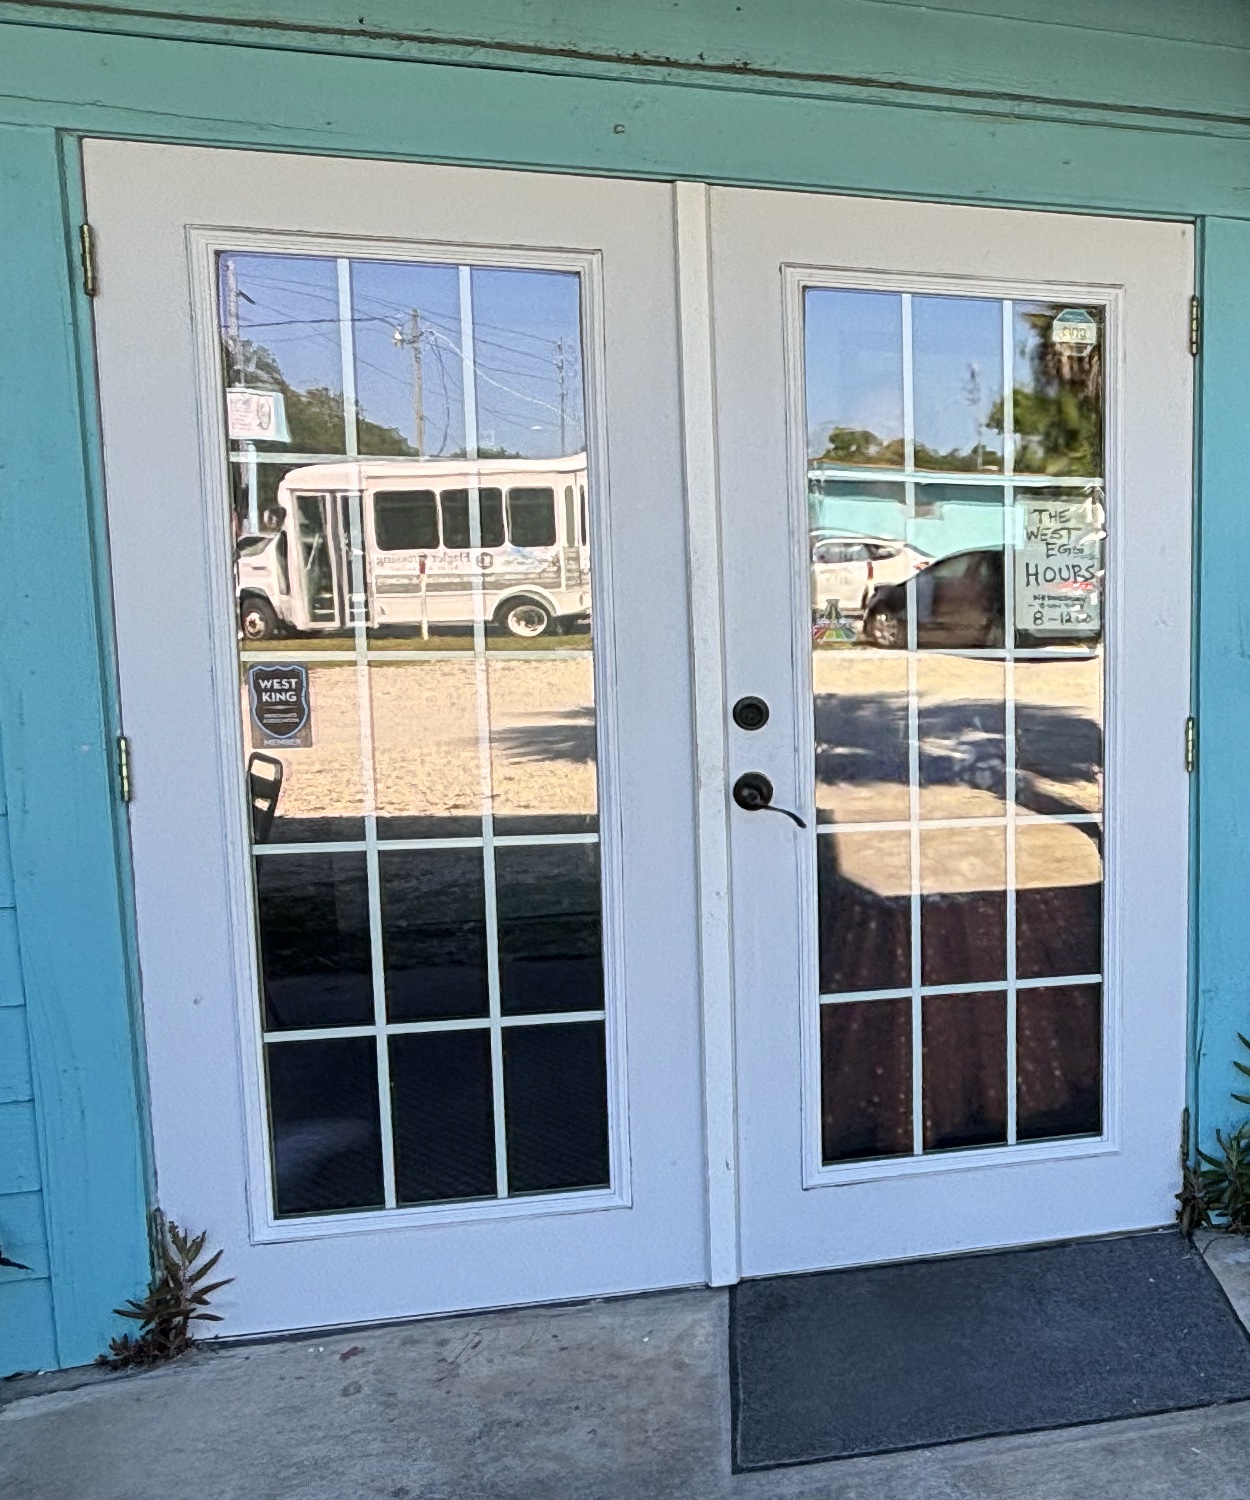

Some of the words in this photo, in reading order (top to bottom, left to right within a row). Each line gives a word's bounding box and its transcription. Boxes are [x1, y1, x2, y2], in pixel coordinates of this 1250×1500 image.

[1031, 508, 1071, 524] THE
[1025, 526, 1083, 542] WEST
[1025, 561, 1096, 588] HOURS
[258, 678, 298, 690] WEST
[262, 691, 298, 703] KING
